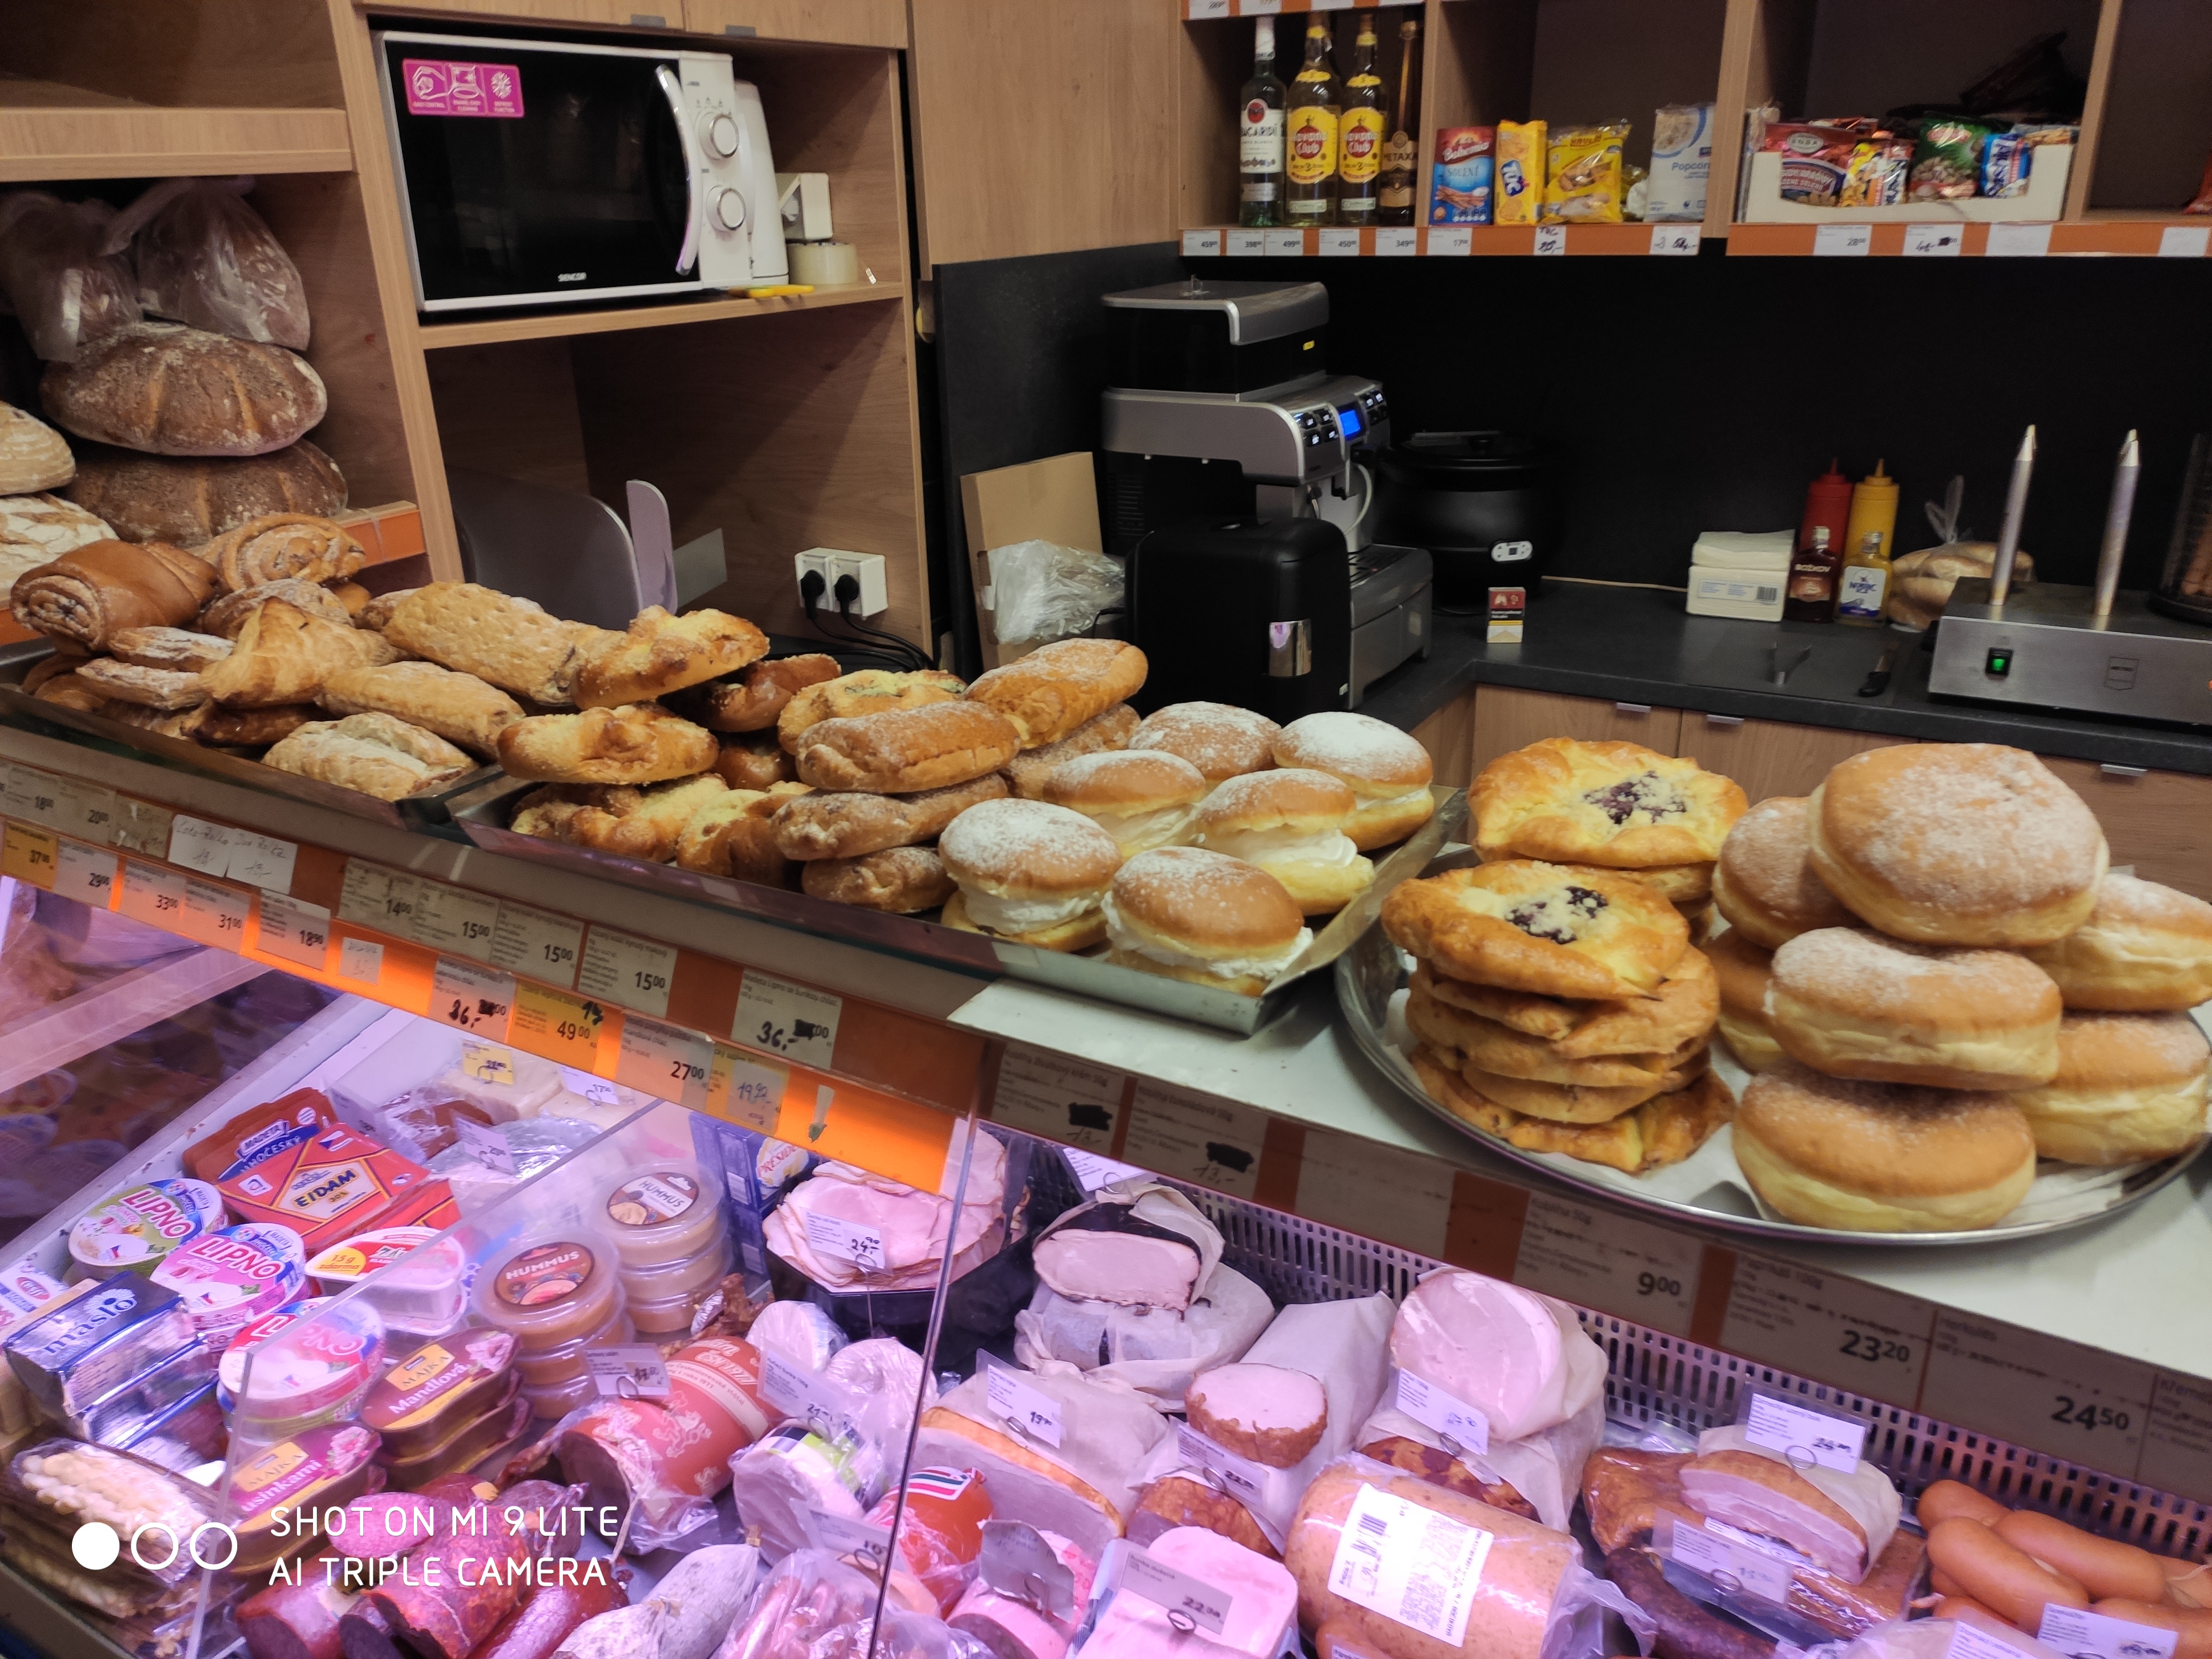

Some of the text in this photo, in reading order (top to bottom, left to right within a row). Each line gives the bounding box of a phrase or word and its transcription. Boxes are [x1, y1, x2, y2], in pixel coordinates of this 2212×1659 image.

[1501, 162, 1522, 196] TUC
[293, 1168, 357, 1208] EIDAM
[638, 1179, 685, 1209] HUMMUS
[118, 1188, 196, 1239] LIPNO
[186, 1237, 286, 1280] LIPNO
[505, 1250, 580, 1280] HUMMUS
[389, 1363, 468, 1415] Mandlová
